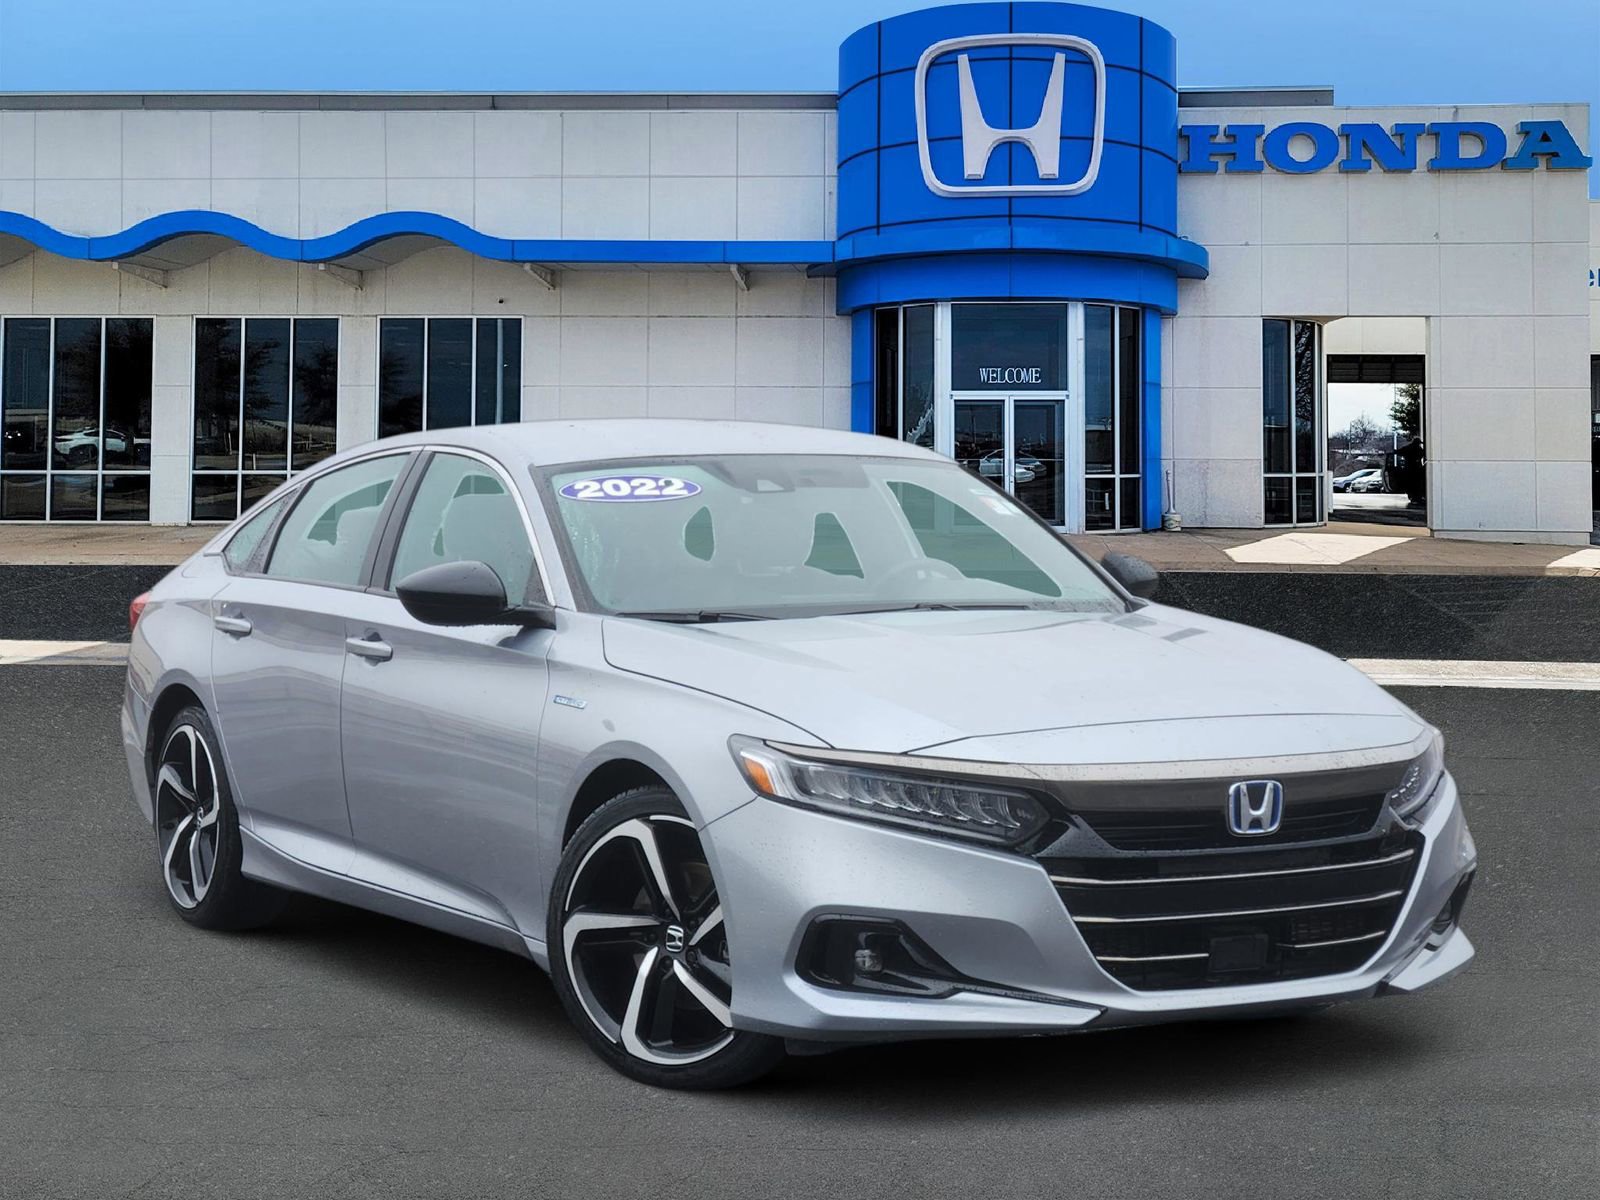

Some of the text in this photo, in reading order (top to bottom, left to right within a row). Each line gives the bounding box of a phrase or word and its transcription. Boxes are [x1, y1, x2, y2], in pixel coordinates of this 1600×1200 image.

[1178, 120, 1593, 174] HONDA
[979, 367, 1042, 384] WELCOME
[573, 477, 689, 499] 2022
